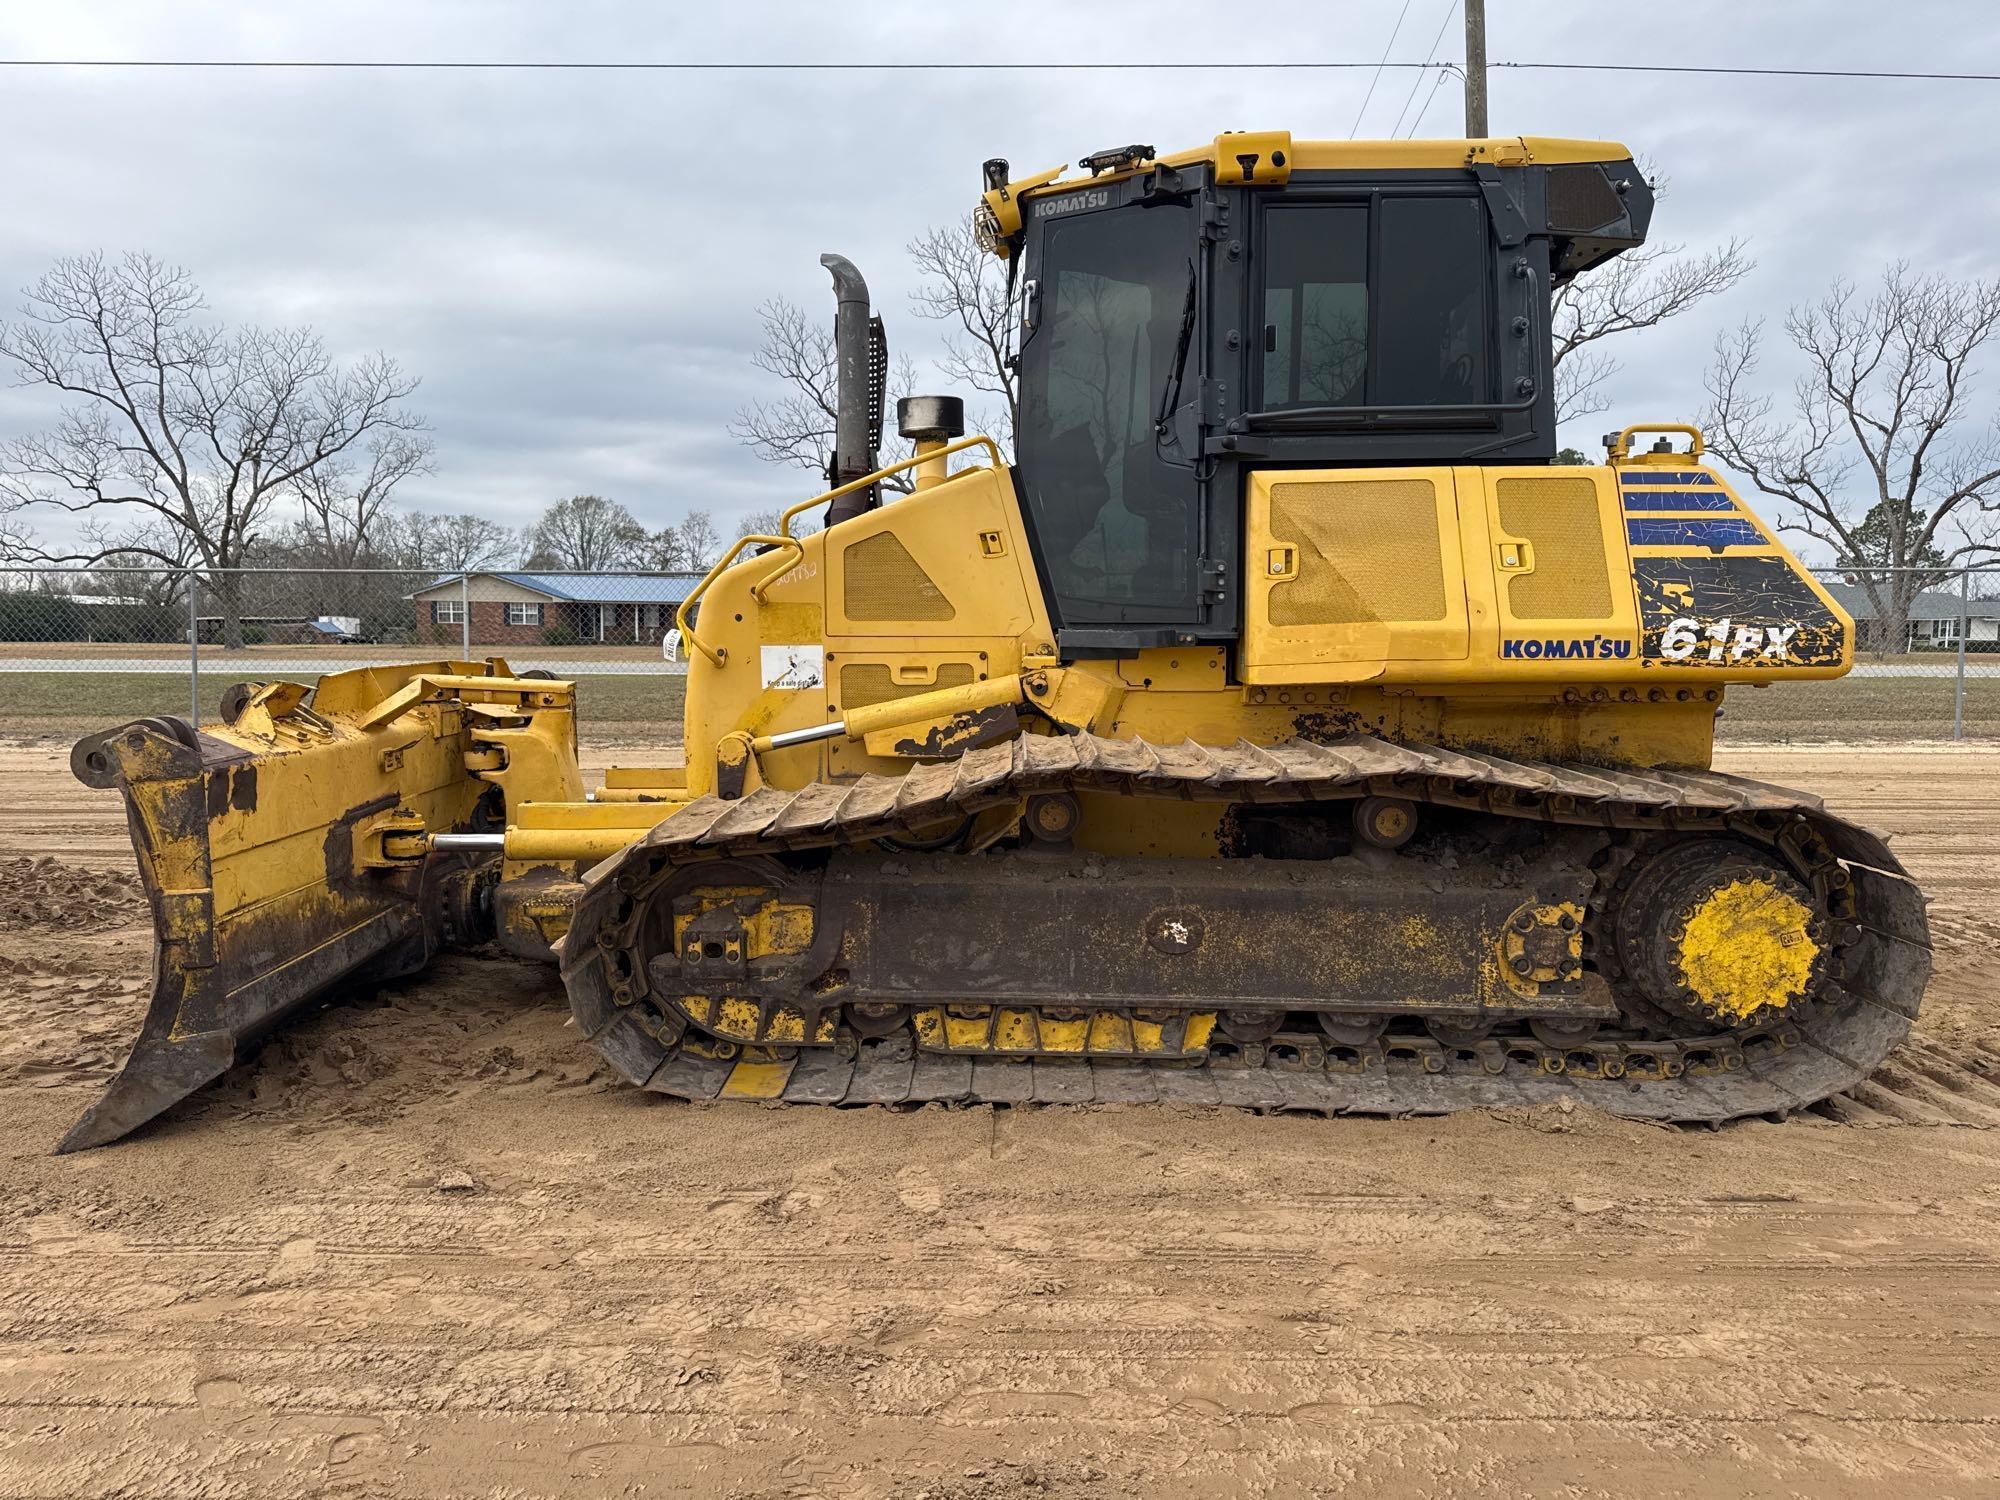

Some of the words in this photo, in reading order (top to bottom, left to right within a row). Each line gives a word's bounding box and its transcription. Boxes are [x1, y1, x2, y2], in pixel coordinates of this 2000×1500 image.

[1034, 191, 1108, 217] KOMATSU
[1503, 634, 1632, 659] KOMATSU
[1660, 617, 1798, 661] 61PX
